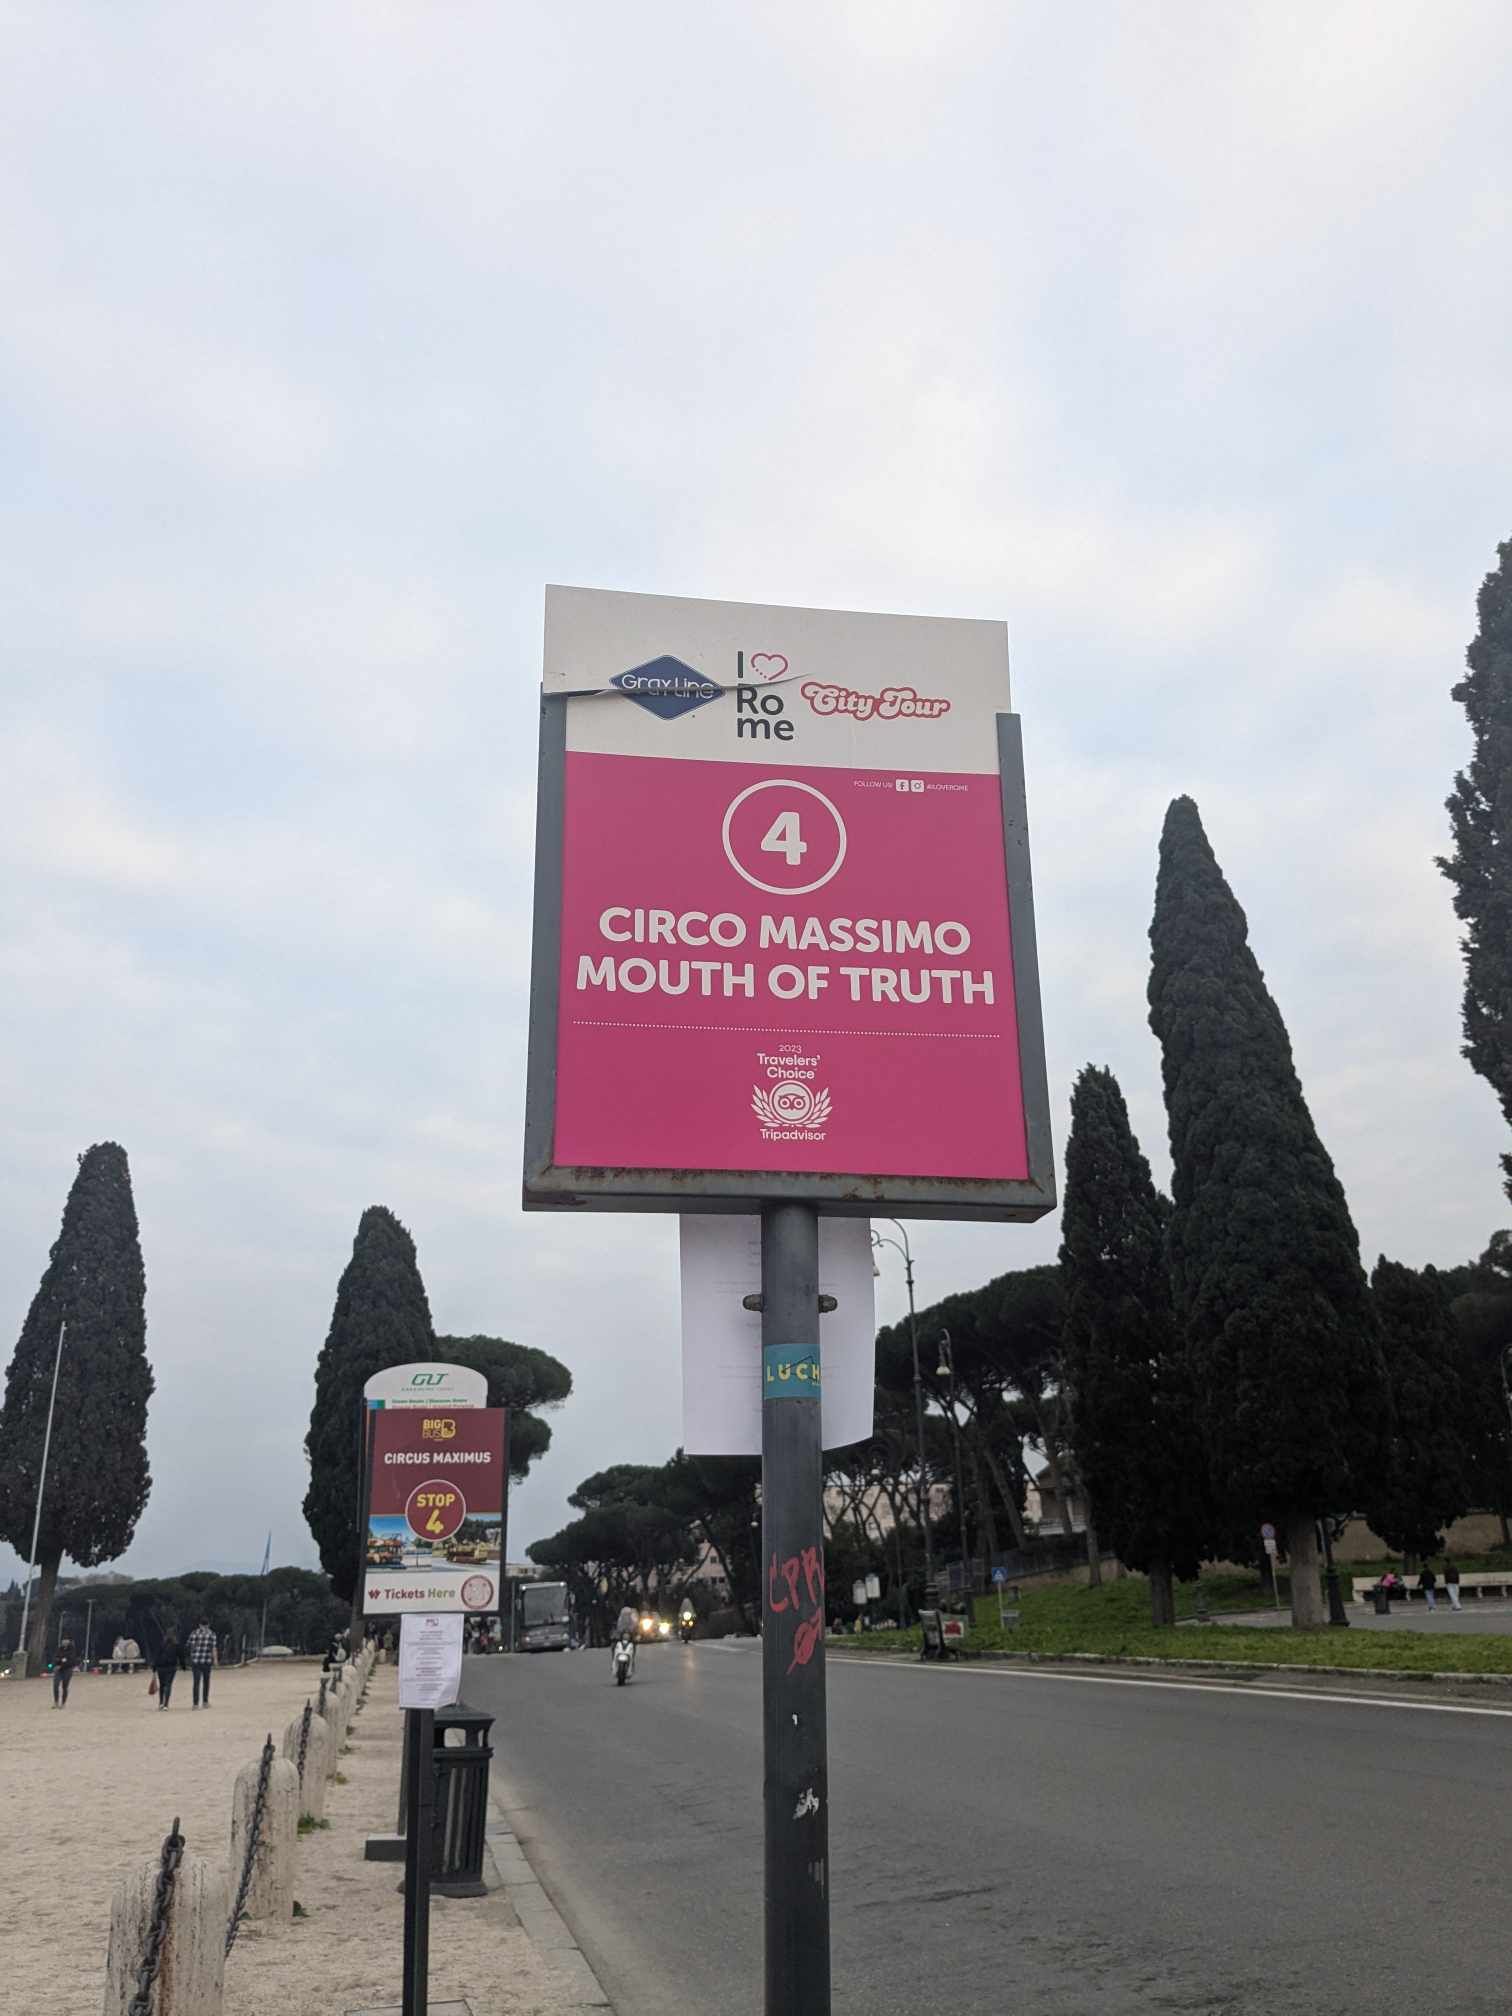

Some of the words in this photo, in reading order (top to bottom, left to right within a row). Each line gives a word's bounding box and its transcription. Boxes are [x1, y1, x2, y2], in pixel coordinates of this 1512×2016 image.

[803, 682, 874, 719] City
[878, 688, 950, 718] Tour
[854, 780, 882, 789] FOLLOW
[760, 811, 807, 866] 4
[599, 907, 747, 947] CIRCO
[759, 916, 971, 955] MASSIMO
[576, 956, 755, 998] MOUTH
[767, 964, 829, 1000] OF
[840, 966, 995, 1005] TRUTH
[778, 1044, 802, 1054] 2023
[757, 1053, 821, 1066] Travelers'
[760, 1128, 827, 1141] Tripadvisor
[422, 1419, 441, 1429] BIG
[384, 1452, 431, 1465] CIRCUS
[432, 1451, 492, 1465] MAXIMUS
[416, 1493, 456, 1509] STOP
[425, 1510, 445, 1535] 4
[384, 1588, 425, 1600] Tickets
[427, 1588, 456, 1598] Here
